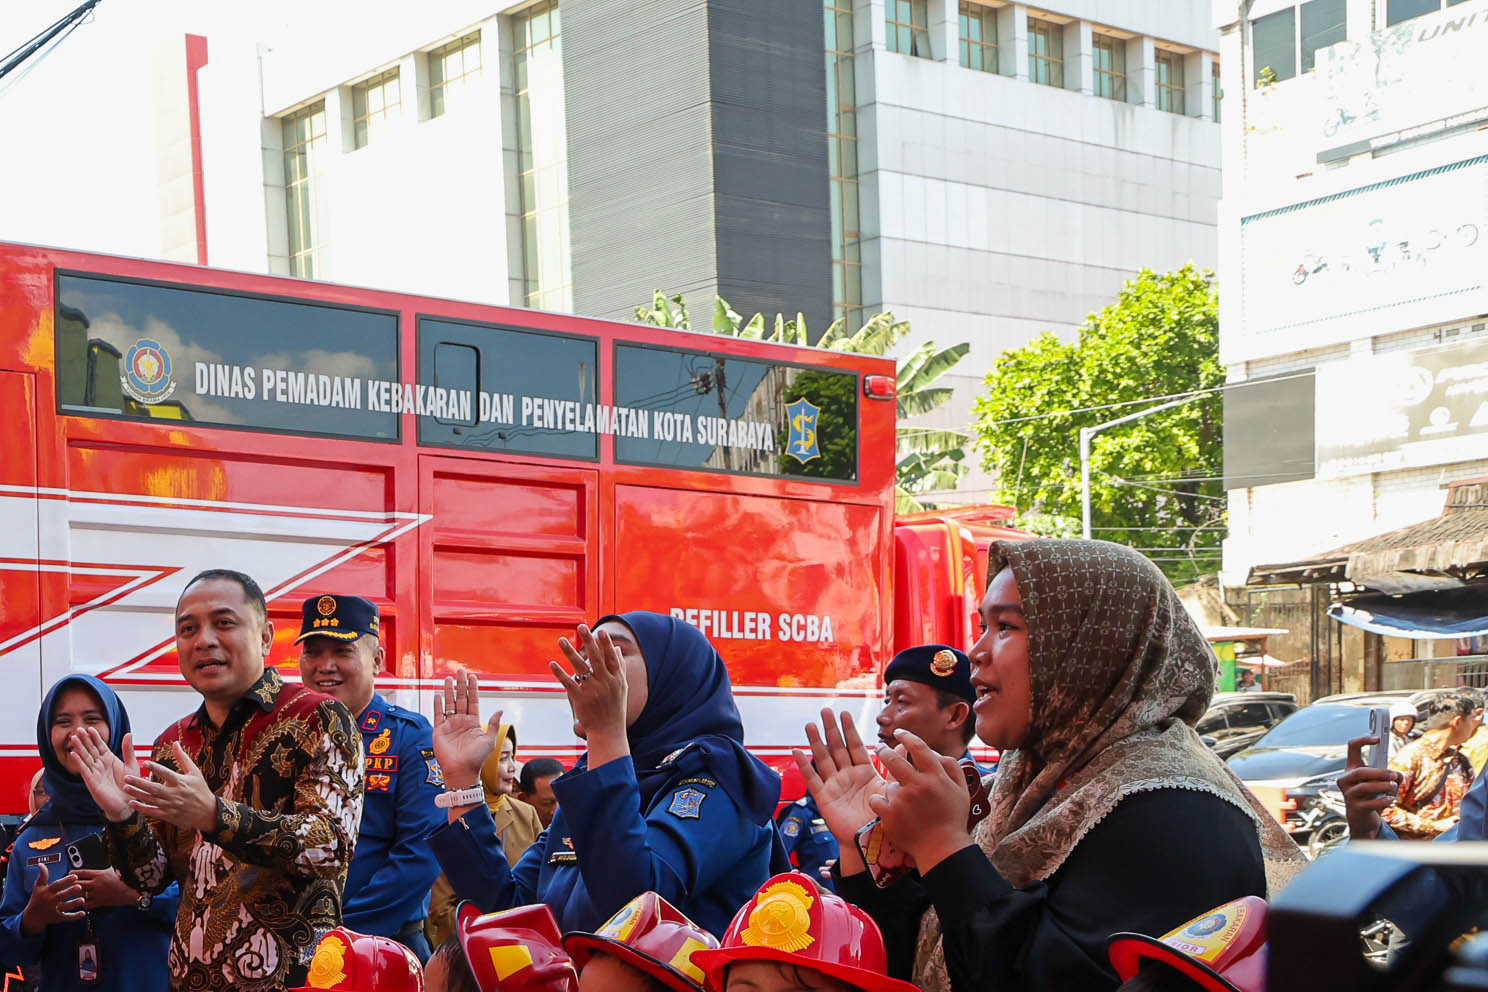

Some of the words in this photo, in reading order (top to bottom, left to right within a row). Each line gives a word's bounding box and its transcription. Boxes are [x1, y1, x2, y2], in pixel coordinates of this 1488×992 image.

[195, 361, 256, 400] DINAS
[262, 368, 361, 410] PEMADAM
[368, 379, 472, 422] KEBAKARAN
[479, 391, 513, 425] DAN
[521, 396, 649, 439] PENYELAMATAN
[653, 410, 693, 444] KOTA
[697, 415, 775, 451] SURABAYA
[778, 612, 834, 643] SCBA
